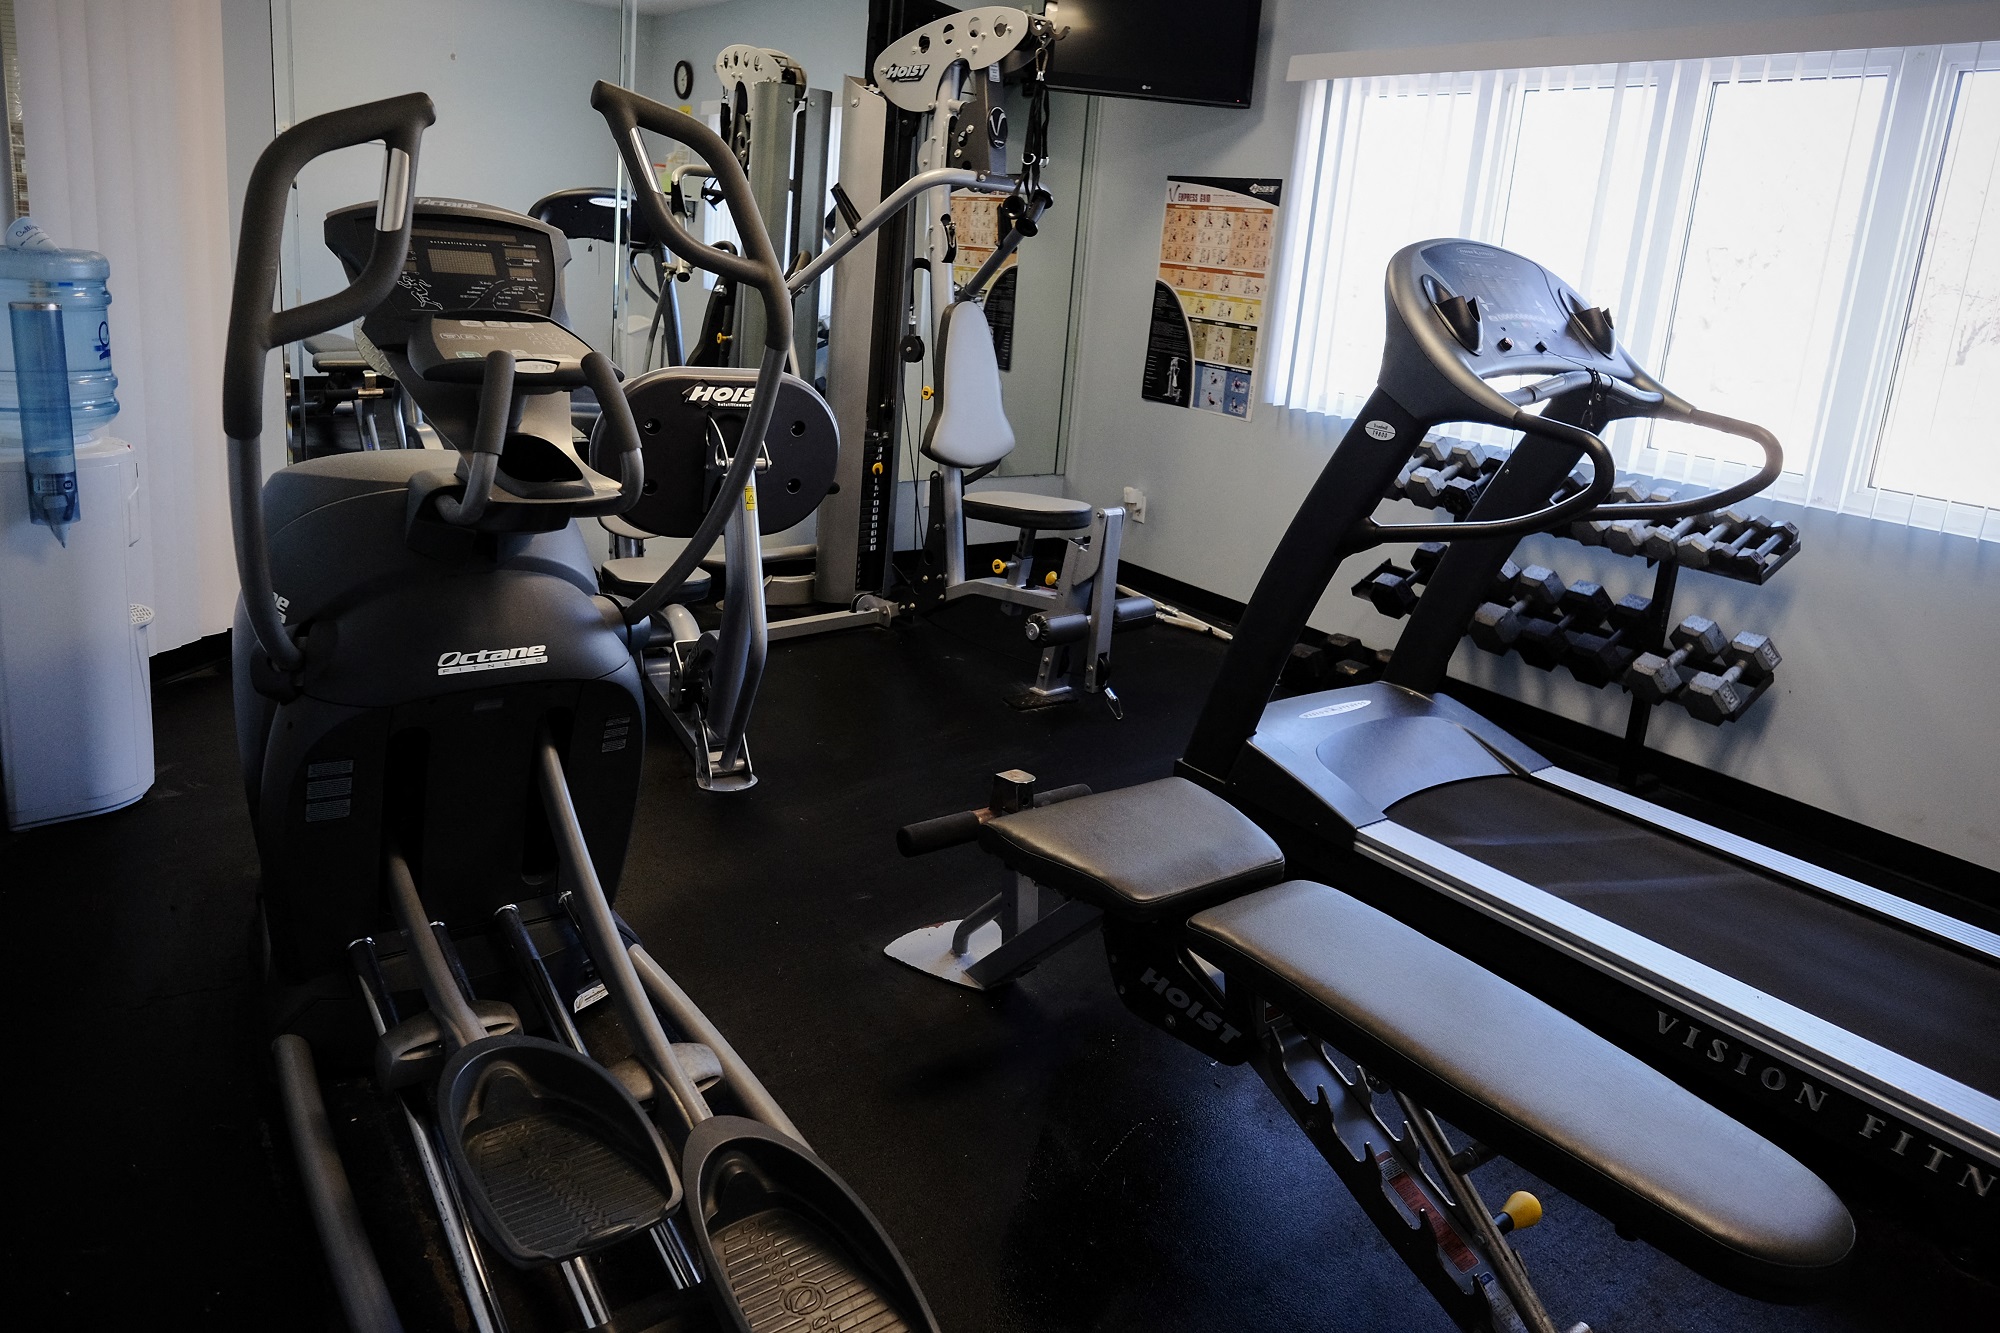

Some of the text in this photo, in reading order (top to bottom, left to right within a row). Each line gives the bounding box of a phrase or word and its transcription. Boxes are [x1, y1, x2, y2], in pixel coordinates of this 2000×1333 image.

[886, 64, 930, 79] HOIST
[688, 386, 756, 402] HOIS
[437, 644, 547, 667] Octane
[442, 657, 542, 674] FITNESS
[1140, 966, 1242, 1044] HOIST
[1657, 1009, 1829, 1113] VISION
